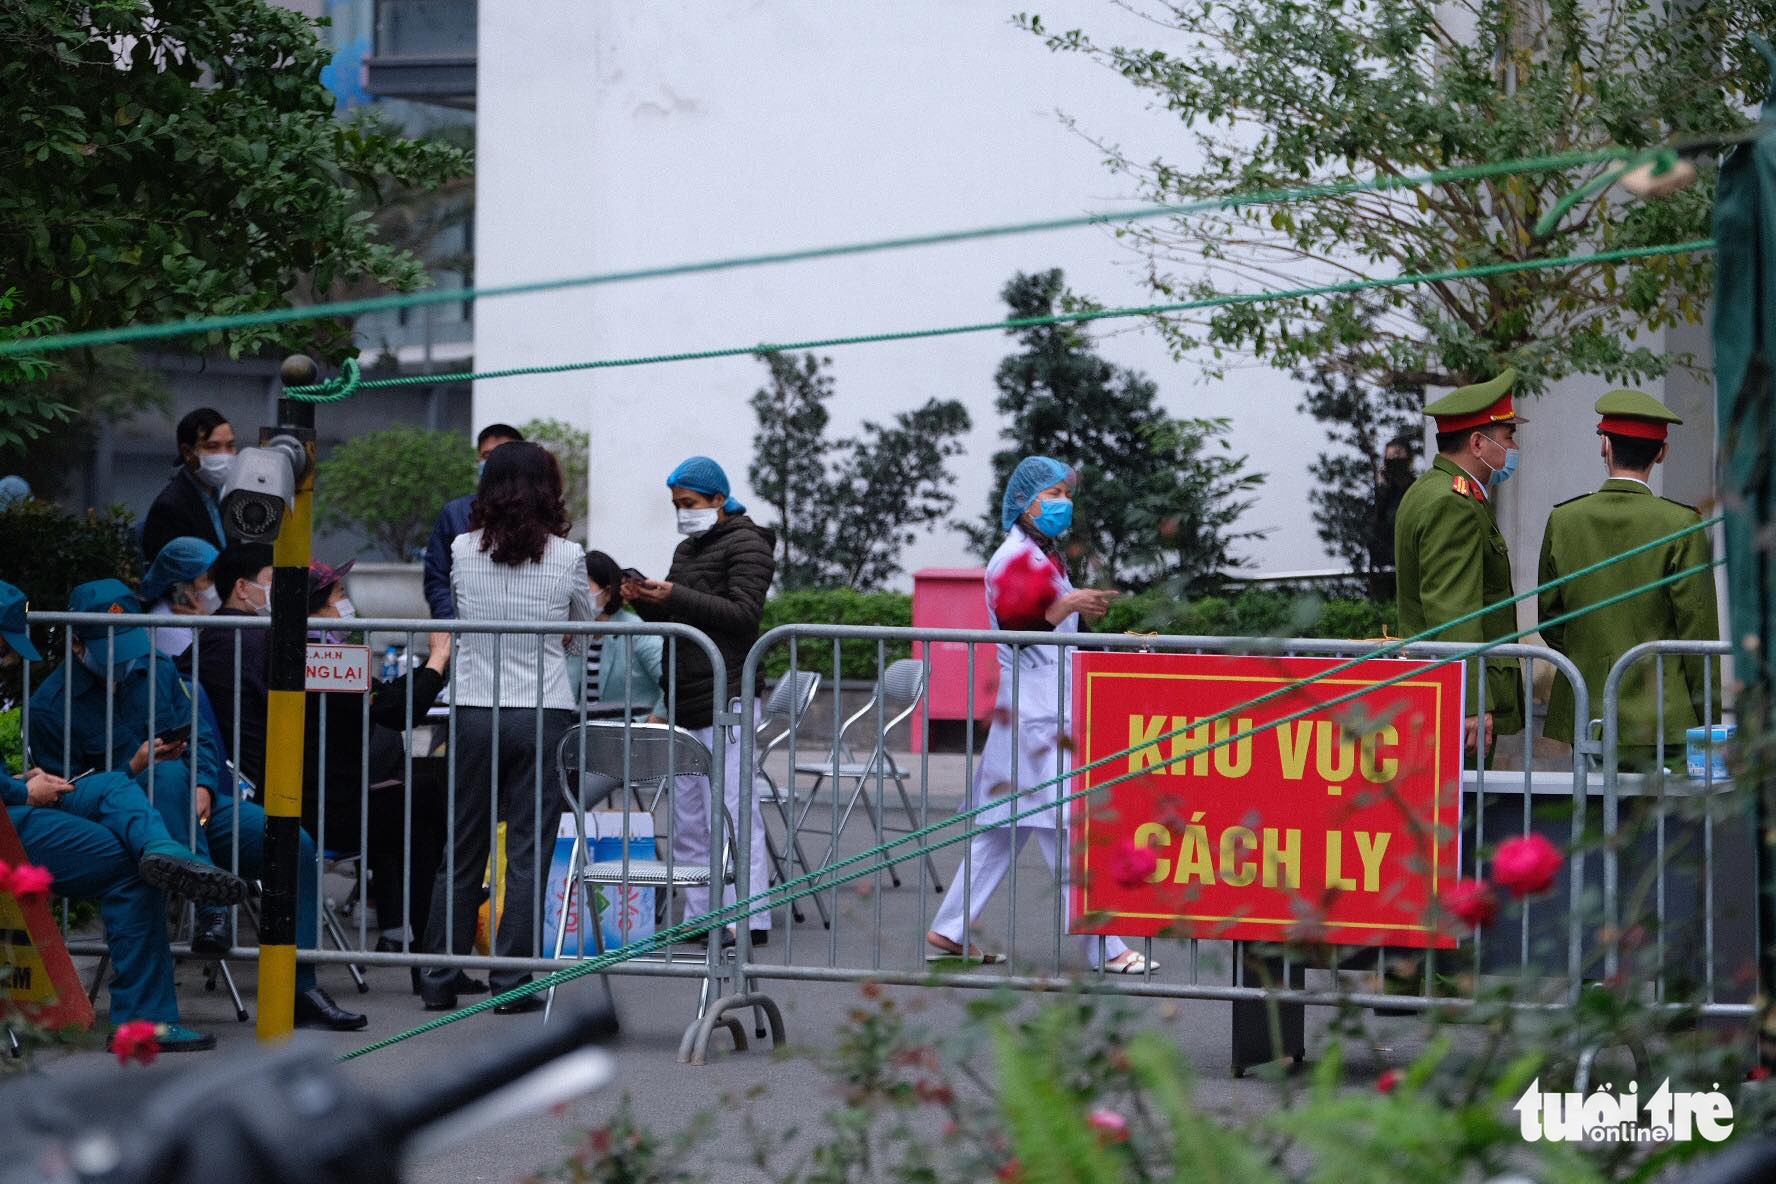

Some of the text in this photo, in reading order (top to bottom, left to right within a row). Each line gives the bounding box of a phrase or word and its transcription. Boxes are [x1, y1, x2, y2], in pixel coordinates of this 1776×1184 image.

[305, 651, 342, 660] .A.H.N
[333, 666, 362, 682] LẠI
[1128, 714, 1253, 778] KHU
[1133, 811, 1392, 892] CÁCH LY
